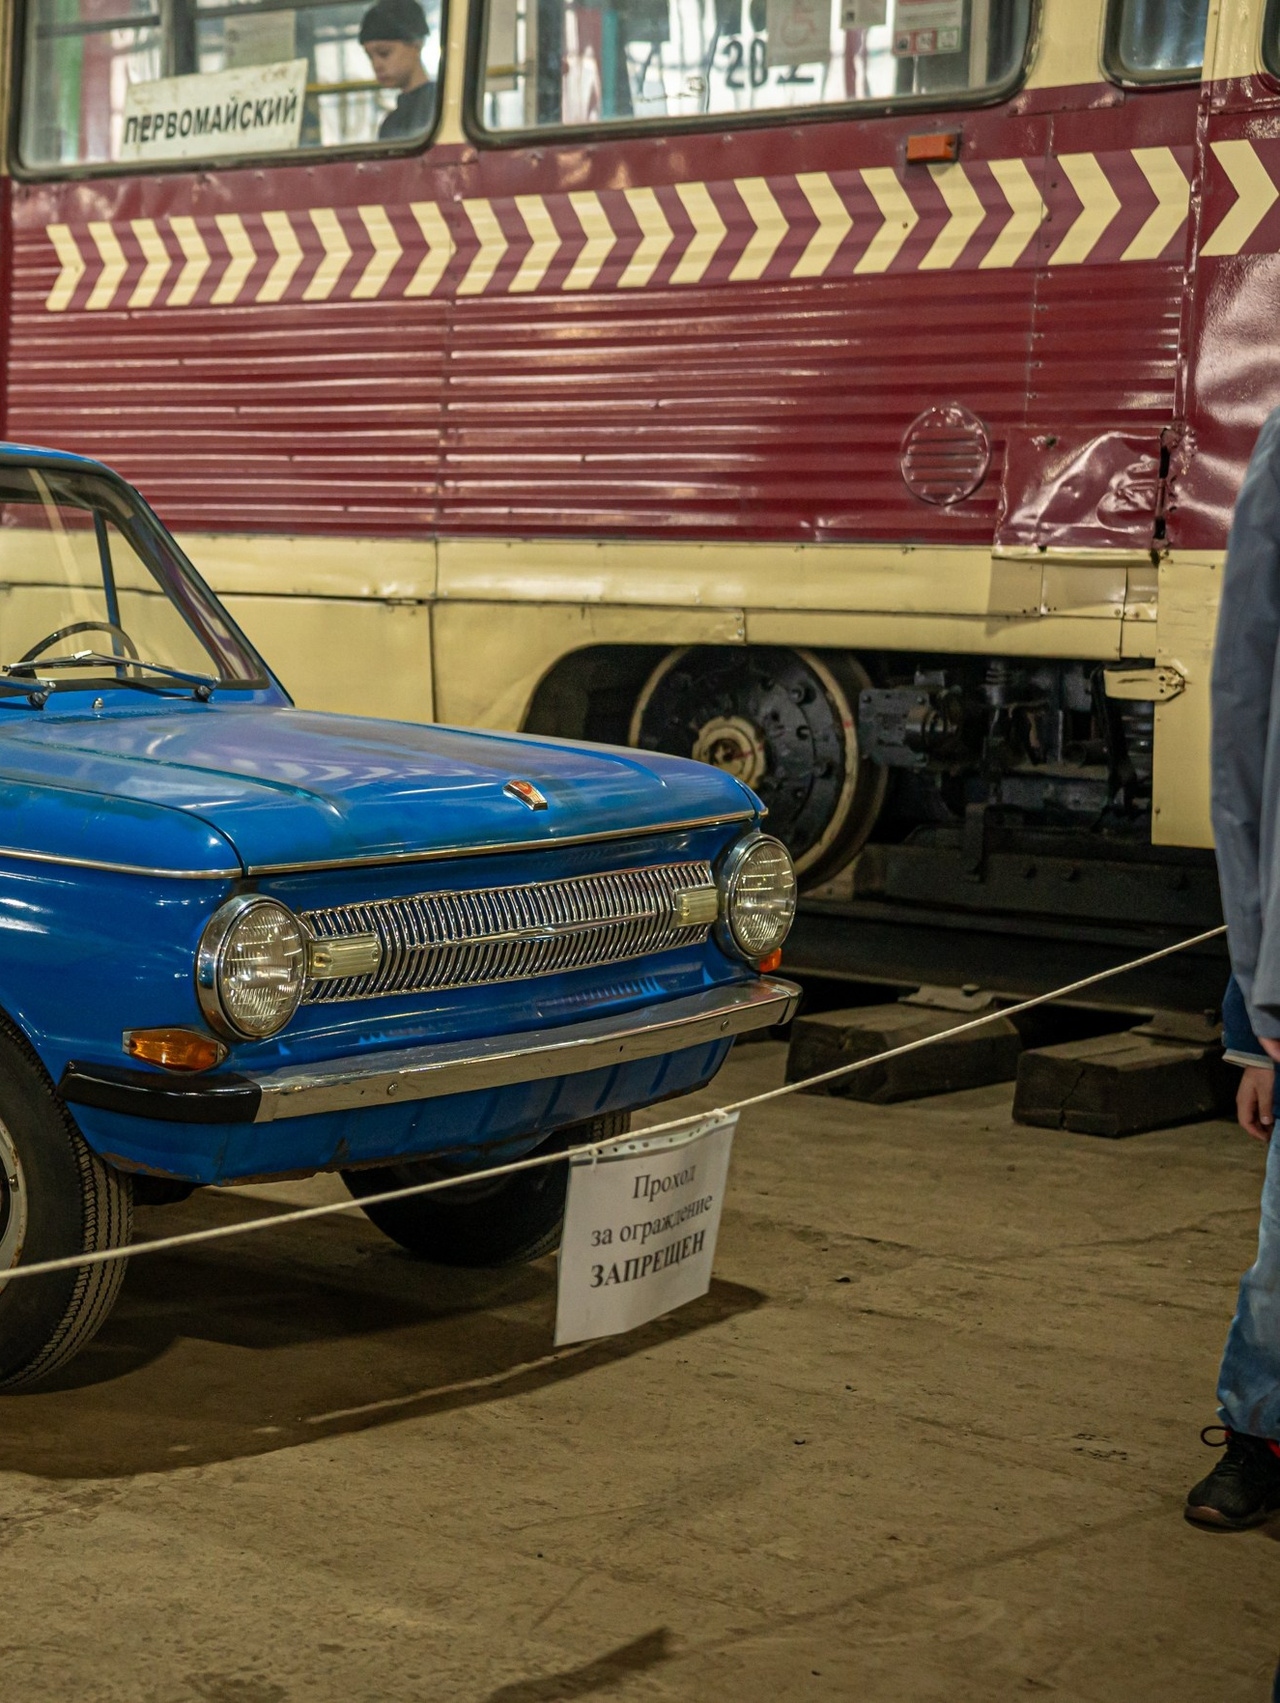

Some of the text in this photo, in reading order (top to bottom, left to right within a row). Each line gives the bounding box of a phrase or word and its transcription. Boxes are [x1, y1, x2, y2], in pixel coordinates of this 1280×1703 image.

[124, 88, 297, 144] ПЕРВОМАЙСКИЙ
[632, 1165, 696, 1203] Проход
[591, 1194, 713, 1247] за ограждение
[590, 1229, 706, 1288] ЗАПРЕЩЕН
